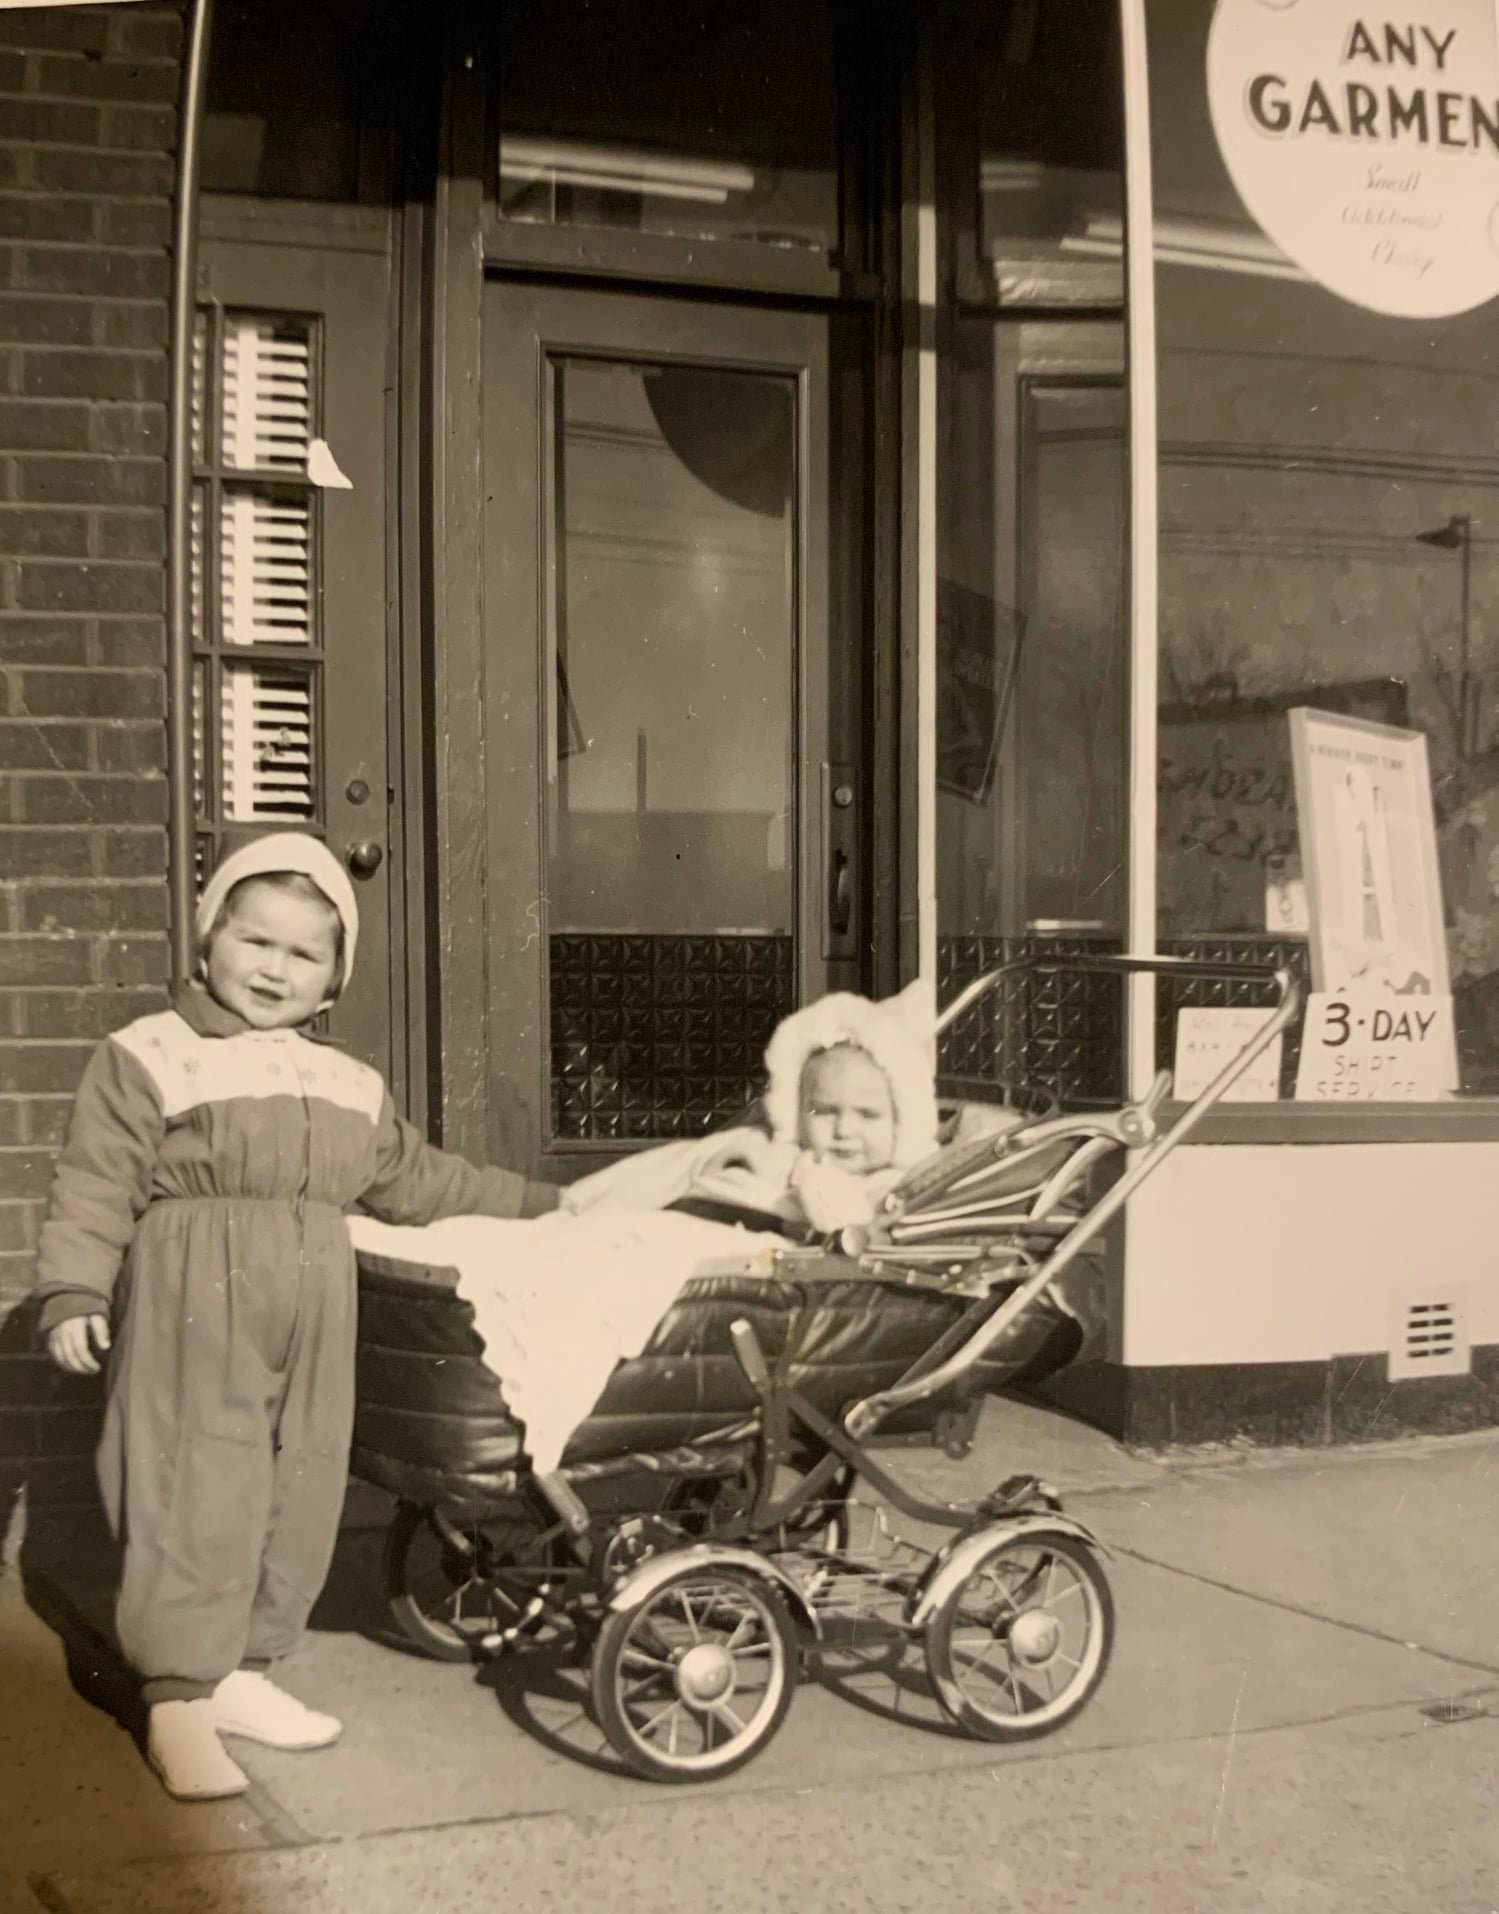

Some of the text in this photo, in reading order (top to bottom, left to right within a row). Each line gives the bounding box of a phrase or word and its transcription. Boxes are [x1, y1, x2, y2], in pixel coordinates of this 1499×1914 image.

[1346, 18, 1457, 70] ANY
[1248, 73, 1499, 153] GARMEN
[1334, 1054, 1398, 1077] SHRT
